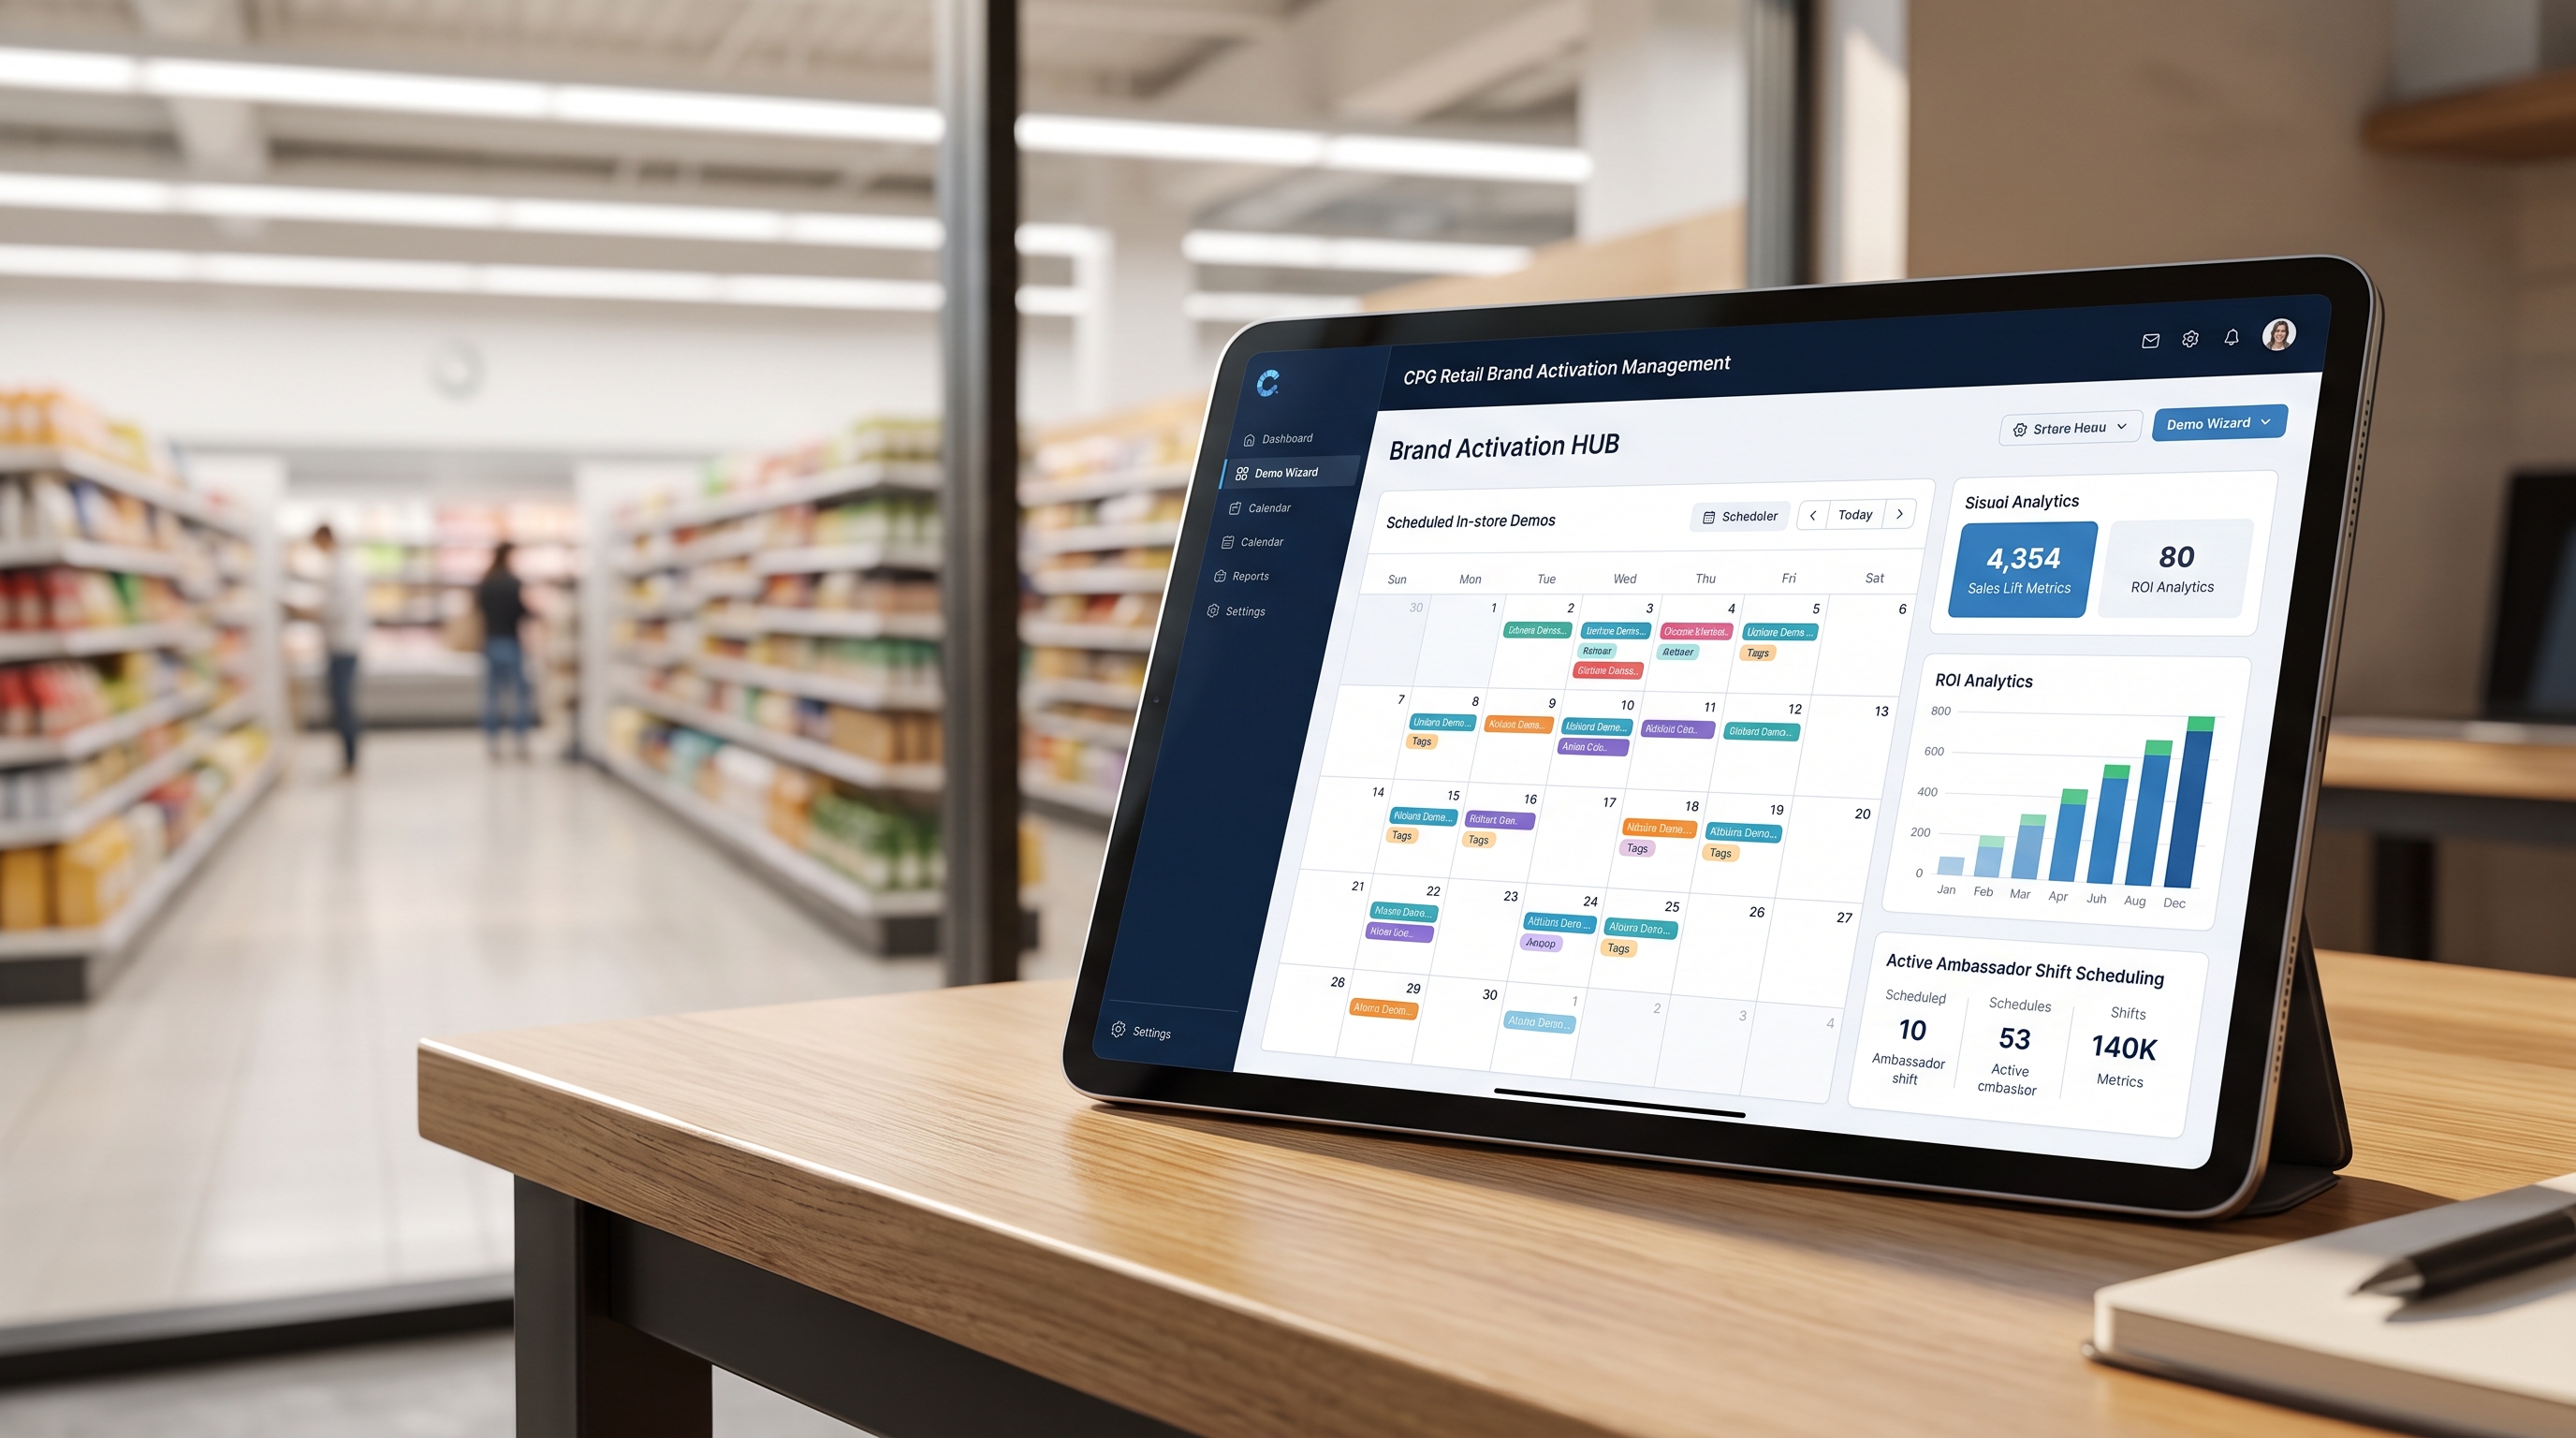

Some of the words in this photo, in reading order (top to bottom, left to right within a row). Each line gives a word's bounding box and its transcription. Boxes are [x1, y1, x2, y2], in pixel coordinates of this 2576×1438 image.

[1403, 369, 1437, 386] CPG
[1440, 367, 1483, 383] Retail
[1487, 364, 1532, 381] Brand
[1536, 360, 1617, 378] Activation
[1621, 355, 1731, 376] Management
[2167, 418, 2203, 431] Demo
[2207, 417, 2250, 429] Wizard
[1262, 433, 1313, 444] Dashboard
[1389, 439, 1452, 460] Brand
[1456, 435, 1565, 458] Activation
[1571, 433, 1620, 455] HUB
[1254, 468, 1282, 478] Demo
[1285, 467, 1319, 477] Wizard
[1249, 503, 1291, 513] Calendar
[2012, 494, 2080, 511] Analytics
[1838, 509, 1873, 522] Today
[1386, 516, 1454, 529] Scheduled
[1456, 514, 1508, 528] In-store
[1510, 514, 1556, 527] Demos
[1241, 537, 1283, 547] Calendar
[1986, 547, 2061, 574] 4,354
[2159, 546, 2195, 568] 80
[1233, 571, 1269, 583] Reports
[1387, 575, 1407, 584] Sun
[1459, 574, 1482, 584] Mon
[1538, 574, 1556, 584] Tue
[1614, 573, 1637, 584] Wed
[1696, 573, 1716, 584] Thu
[1782, 573, 1797, 583] Fri
[1865, 573, 1884, 583] Sat
[1969, 582, 2000, 594] Sales
[2003, 581, 2023, 594] Lift
[2026, 581, 2071, 594] Metrics
[2131, 581, 2154, 593] ROI
[2157, 580, 2215, 595] Analytics
[1226, 607, 1266, 618] Settings
[1410, 602, 1423, 612] 30
[1491, 603, 1497, 612] 1
[1567, 603, 1574, 613] 2
[1647, 603, 1653, 613] 3
[1728, 603, 1735, 614] 4
[1813, 604, 1820, 614] 5
[1898, 604, 1907, 614] 6
[1936, 673, 1961, 687] ROI
[1964, 673, 2033, 691] Analytics
[1398, 695, 1405, 705] 7
[1471, 697, 1479, 706] 8
[1548, 698, 1556, 709] 9
[1621, 700, 1634, 710] 10
[1705, 702, 1716, 712] 11
[1789, 704, 1803, 714] 12
[1875, 706, 1889, 717] 13
[1931, 706, 1952, 716] 800
[1412, 736, 1432, 747] Tags
[1925, 746, 1944, 756] 600
[1372, 786, 1384, 797] 14
[1448, 790, 1460, 800] 15
[1918, 787, 1938, 798] 400
[1524, 794, 1537, 804] 16
[1603, 798, 1617, 808] 17
[1685, 801, 1700, 812] 18
[1770, 805, 1784, 815] 19
[1854, 808, 1871, 820] 20
[1393, 830, 1412, 841] Tags
[1910, 828, 1931, 838] 200
[1470, 835, 1488, 845] Tags
[1627, 843, 1647, 854] Tags
[1710, 848, 1732, 859] Tags
[1916, 868, 1923, 878] 0
[1352, 881, 1364, 891] 21
[1937, 885, 1956, 895] Jan
[1427, 887, 1441, 897] 22
[1503, 891, 1518, 902] 23
[1973, 887, 1994, 897] Feb
[2010, 889, 2031, 900] Mar
[2048, 891, 2068, 903] Apr
[1584, 896, 1598, 907] 24
[1665, 902, 1680, 912] 25
[2124, 896, 2146, 909] Aug
[2163, 898, 2187, 909] Dec
[1749, 906, 1765, 917] 26
[1837, 912, 1852, 923] 27
[1608, 943, 1630, 955] Tags
[1886, 953, 1933, 970] Active
[1937, 957, 2031, 976] Ambassador
[2035, 963, 2071, 979] Shift
[2075, 966, 2165, 989] Scheduling
[1406, 983, 1421, 994] 29
[1483, 989, 1498, 1000] 30
[1573, 996, 1578, 1006] 1
[1989, 997, 2052, 1012] Schedules
[1653, 1004, 1661, 1014] 2
[2111, 1006, 2146, 1020] Shifts
[1739, 1010, 1747, 1021] 3
[1827, 1018, 1835, 1029] 4
[1133, 1027, 1171, 1041] Settings
[1898, 1019, 1926, 1041] 10
[1998, 1027, 2030, 1050] 53
[2092, 1034, 2159, 1061] 140K
[1872, 1052, 1945, 1070] Ambassador
[1991, 1063, 2029, 1078] Active
[1892, 1073, 1918, 1086] shift
[2097, 1073, 2144, 1088] Metrics
